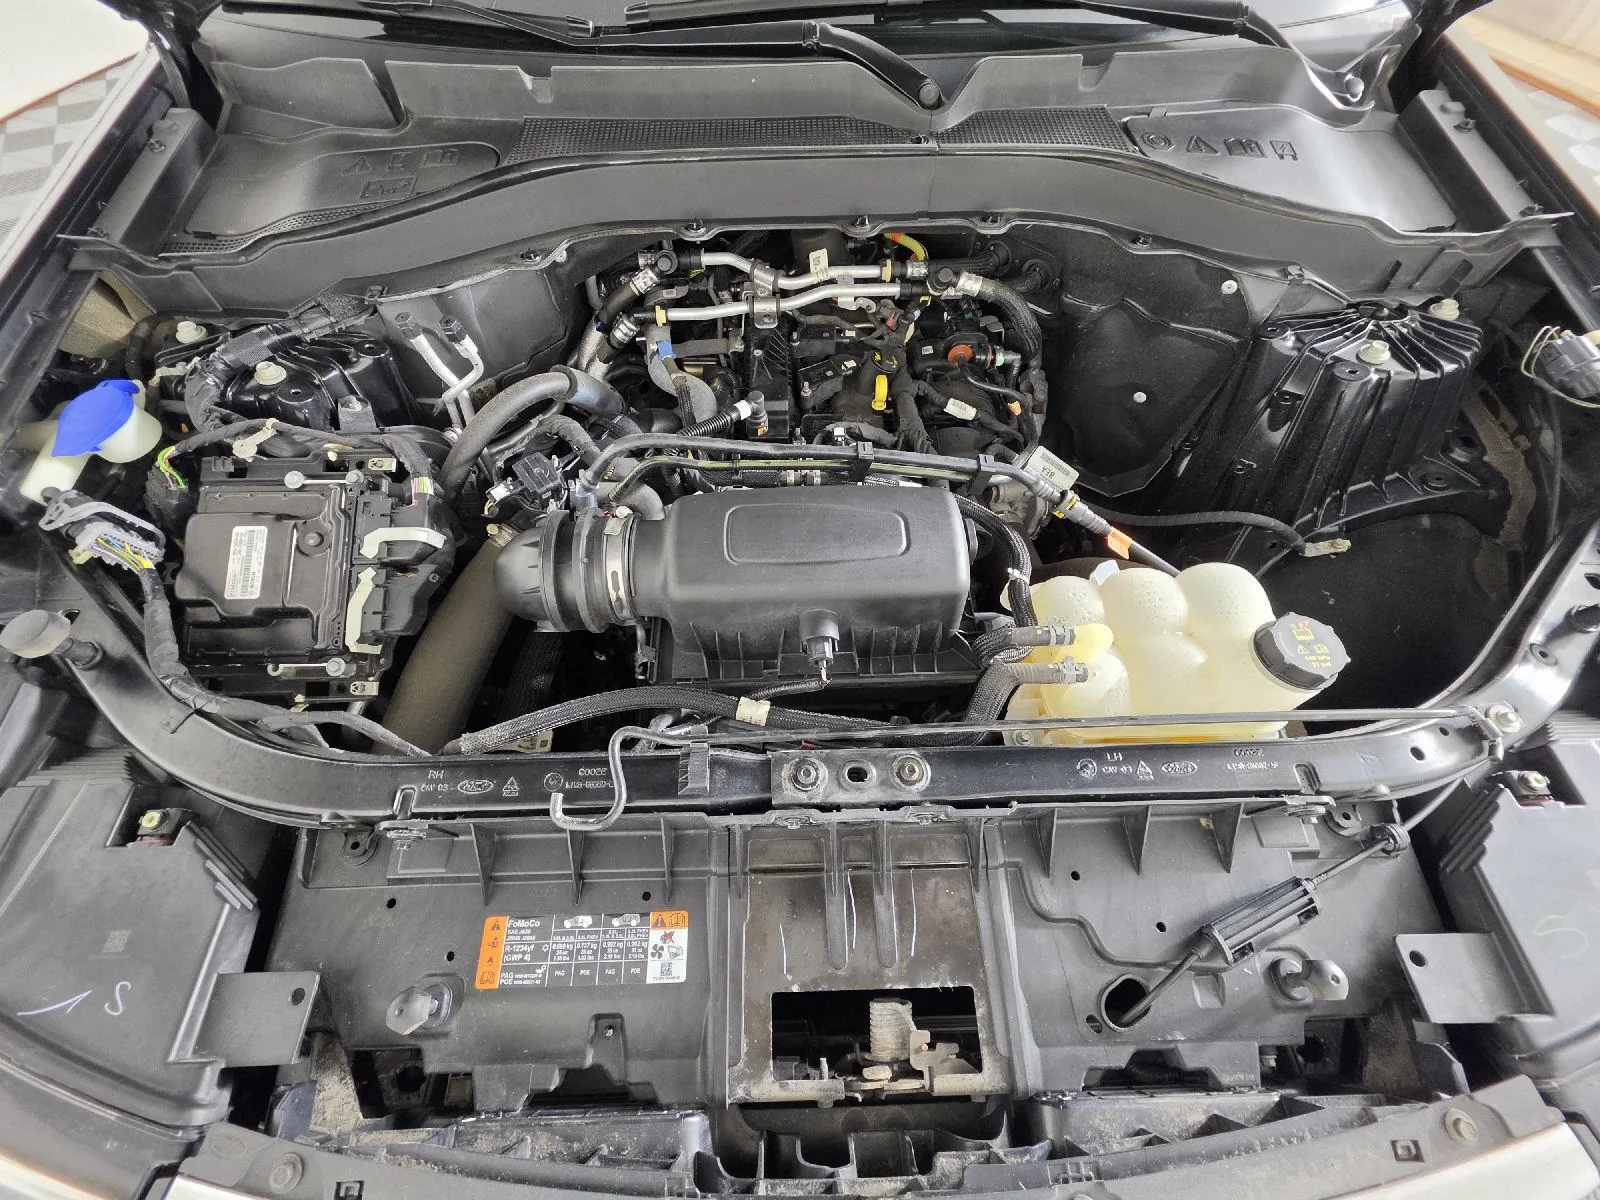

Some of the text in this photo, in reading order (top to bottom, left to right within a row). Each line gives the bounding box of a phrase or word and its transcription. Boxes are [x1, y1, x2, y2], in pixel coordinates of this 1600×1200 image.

[1106, 752, 1123, 762] LH
[428, 769, 444, 780] RH
[508, 919, 541, 928] FoMoCo
[505, 944, 535, 953] R-1234yf
[617, 941, 624, 949] kg
[503, 953, 531, 963] (GWP 4)
[554, 969, 566, 977] PAG
[579, 968, 591, 976] POE
[605, 967, 616, 975] PAG
[103, 980, 132, 1016] S
